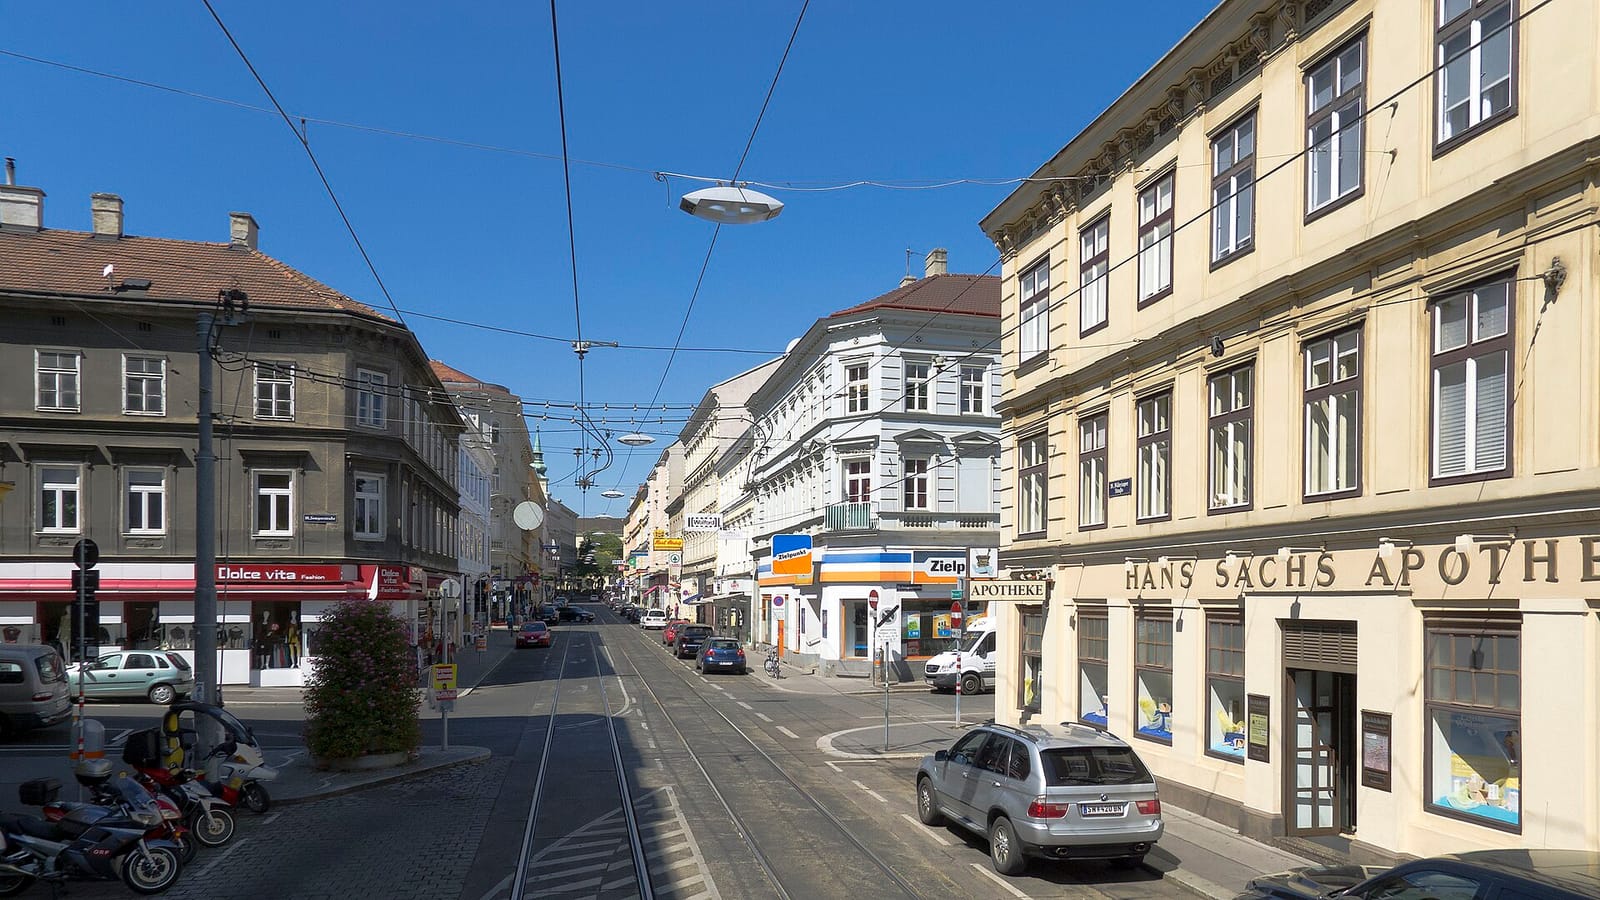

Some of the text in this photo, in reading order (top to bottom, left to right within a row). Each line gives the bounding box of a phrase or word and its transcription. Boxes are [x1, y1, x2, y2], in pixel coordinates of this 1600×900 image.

[778, 549, 807, 560] Zielpunkt
[218, 567, 261, 579] Dolce
[265, 569, 297, 580] vita
[381, 569, 400, 577] Dolce
[1126, 561, 1193, 590] HANS
[1216, 553, 1337, 588] SACHS
[971, 584, 1044, 597] APOTHEKE
